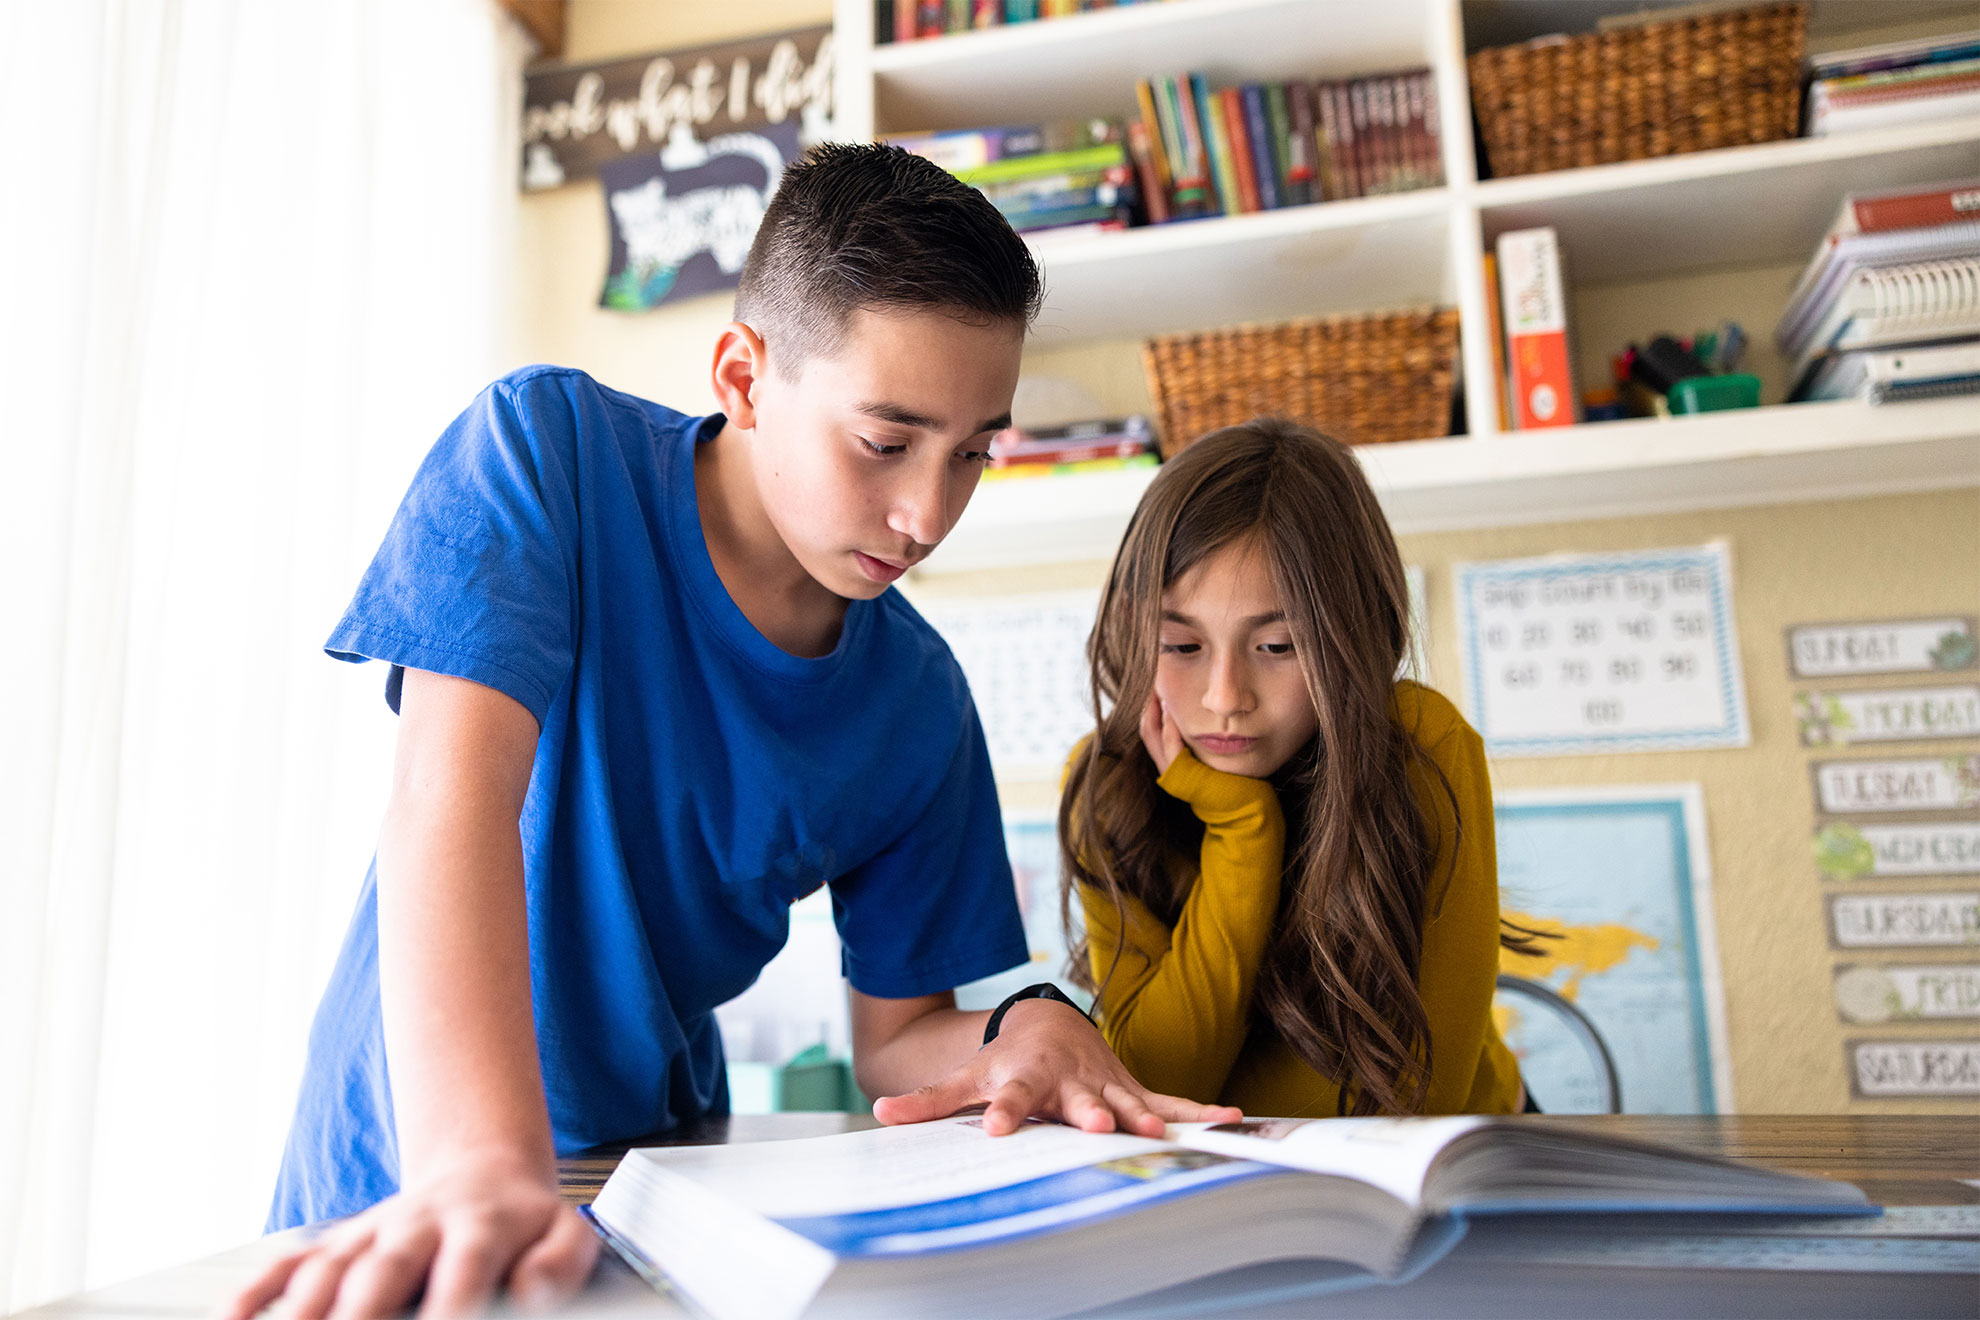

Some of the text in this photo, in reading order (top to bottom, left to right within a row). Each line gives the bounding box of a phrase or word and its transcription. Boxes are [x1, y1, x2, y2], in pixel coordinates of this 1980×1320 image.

[606, 57, 727, 150] what
[727, 56, 750, 122] I
[1520, 619, 1552, 650] 20
[1568, 616, 1602, 647] 30
[1617, 612, 1657, 643] 40
[1672, 608, 1707, 640] 50
[1502, 650, 1699, 690] 60 70 80 90
[1858, 1051, 1980, 1086] SATURDA
